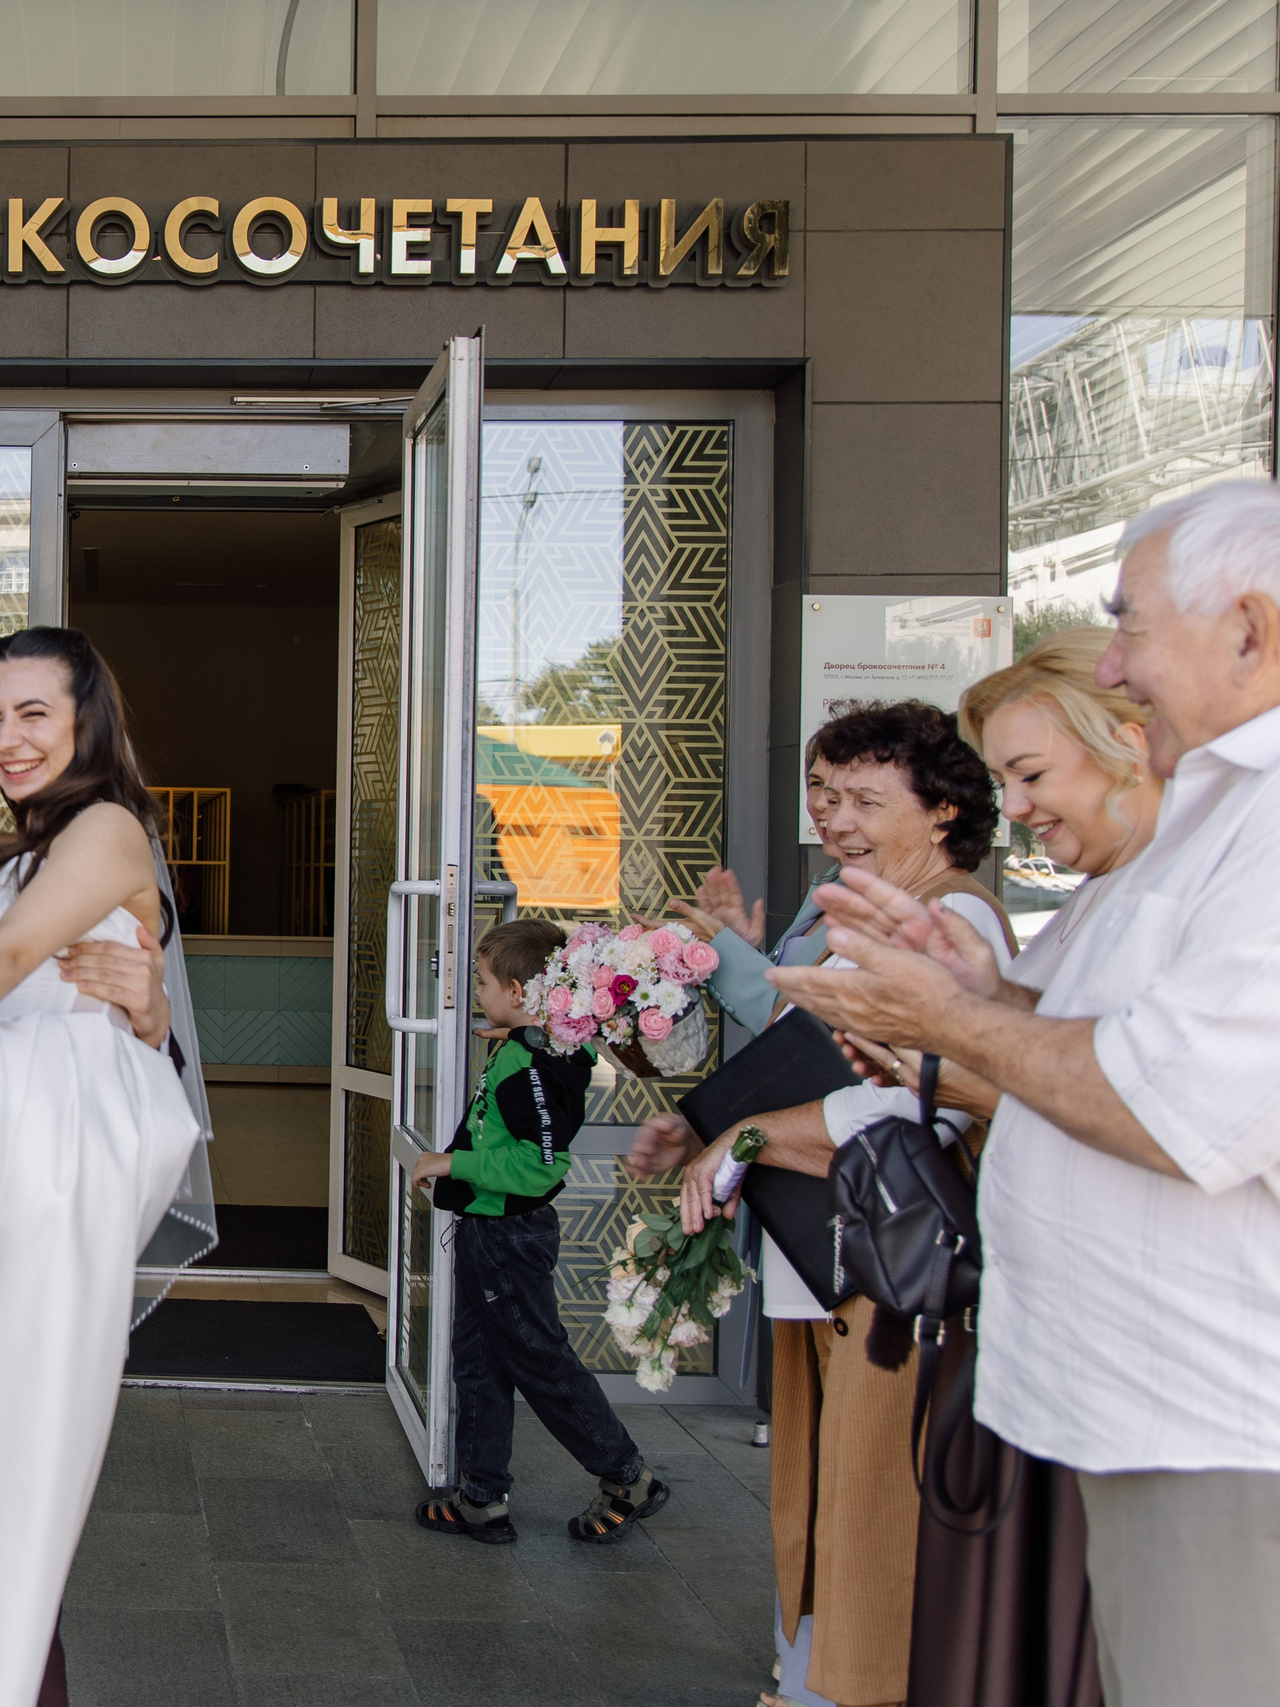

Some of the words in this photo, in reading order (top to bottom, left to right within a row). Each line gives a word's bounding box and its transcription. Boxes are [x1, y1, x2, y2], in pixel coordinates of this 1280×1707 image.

[823, 662, 856, 671] Дворец
[857, 662, 925, 671] бракосочетания
[529, 1068, 541, 1085] NOT
[542, 1135, 552, 1148] DO
[543, 1148, 554, 1166] NOT
